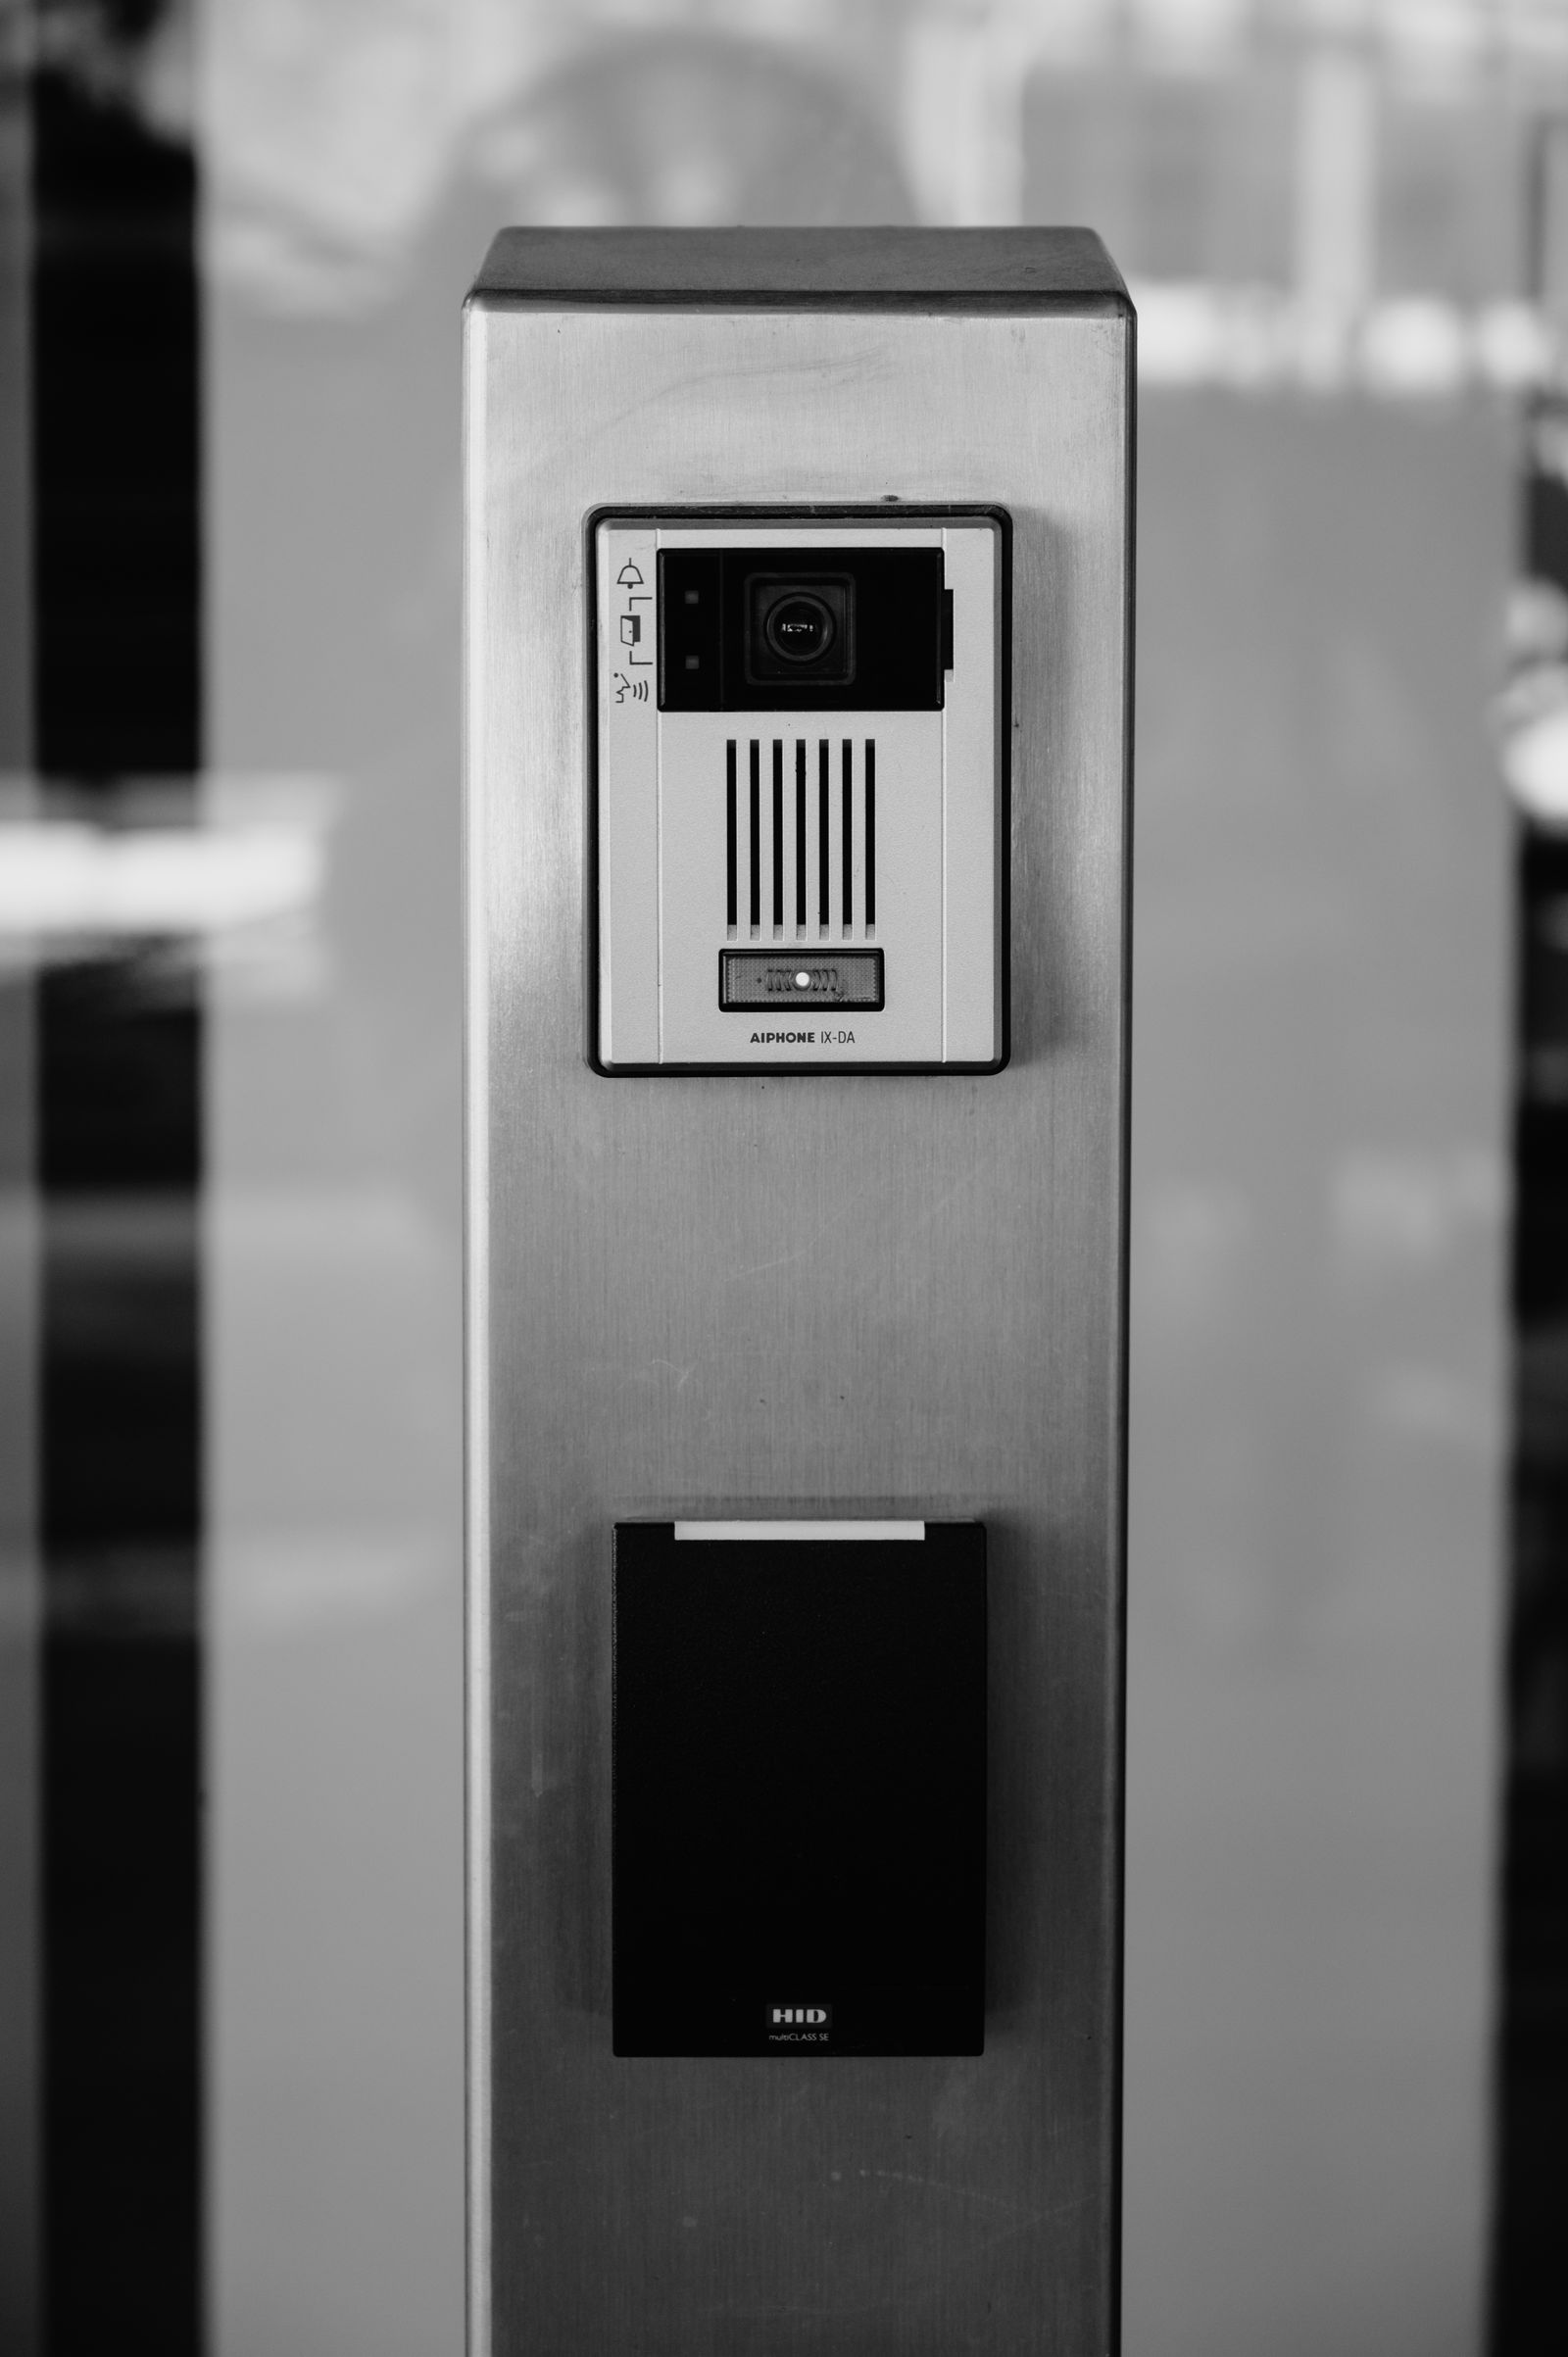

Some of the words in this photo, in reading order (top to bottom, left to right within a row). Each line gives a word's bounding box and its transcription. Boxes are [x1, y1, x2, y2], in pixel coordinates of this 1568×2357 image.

[750, 1032, 815, 1044] AIPHONE
[820, 1031, 856, 1044] IX-DA
[772, 2009, 827, 2024] HID
[818, 2033, 830, 2041] SE
